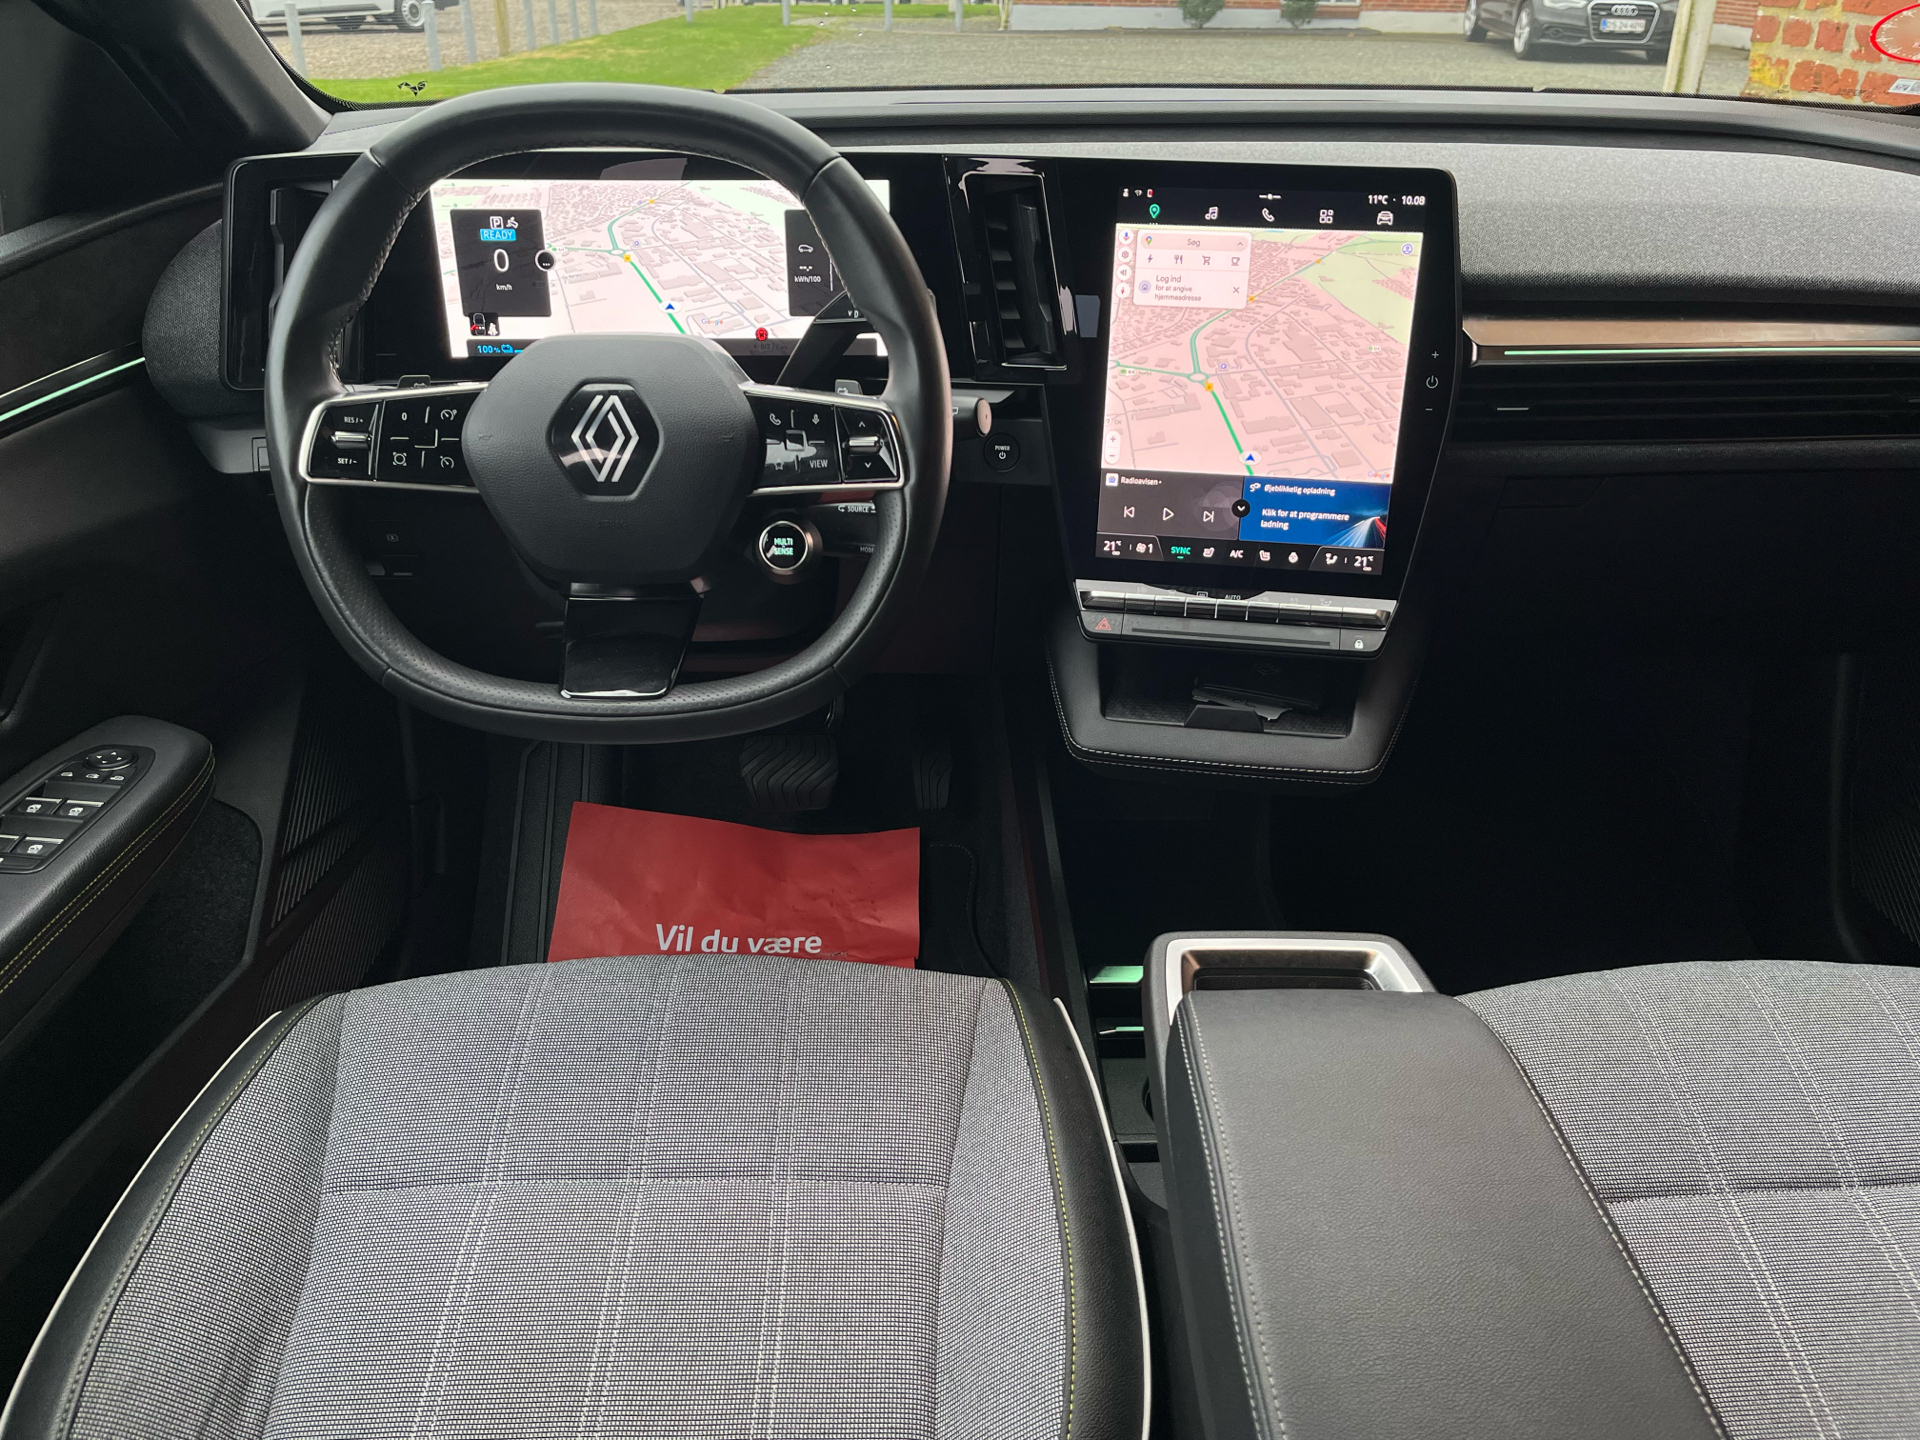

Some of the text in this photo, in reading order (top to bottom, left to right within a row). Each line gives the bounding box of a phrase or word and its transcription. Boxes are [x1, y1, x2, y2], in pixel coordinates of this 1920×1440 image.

[1401, 195, 1426, 206] 10.08
[483, 230, 513, 239] READY
[1187, 238, 1201, 247] Søg
[494, 248, 510, 273] 0
[794, 275, 822, 283] kWh/100
[1156, 275, 1182, 284] Log ind
[496, 283, 513, 291] km/h
[1173, 285, 1193, 293] angive
[1154, 293, 1202, 302] hjemmeadresse
[701, 317, 724, 327] Google
[477, 345, 493, 354] 100
[809, 458, 828, 469] VIEW
[1367, 471, 1390, 479] Google
[1120, 476, 1158, 486] Radioavisen
[1264, 484, 1336, 497] Øjeblikkelig opladning
[1261, 508, 1350, 521] Klik for at programmere
[1260, 519, 1289, 530] ladning
[773, 537, 794, 546] MULTI
[773, 547, 794, 556] SENSE
[1170, 546, 1191, 555] SYNC
[1229, 549, 1244, 559] A/C
[1224, 593, 1241, 601] AUTO
[655, 923, 823, 954] Vil du være
